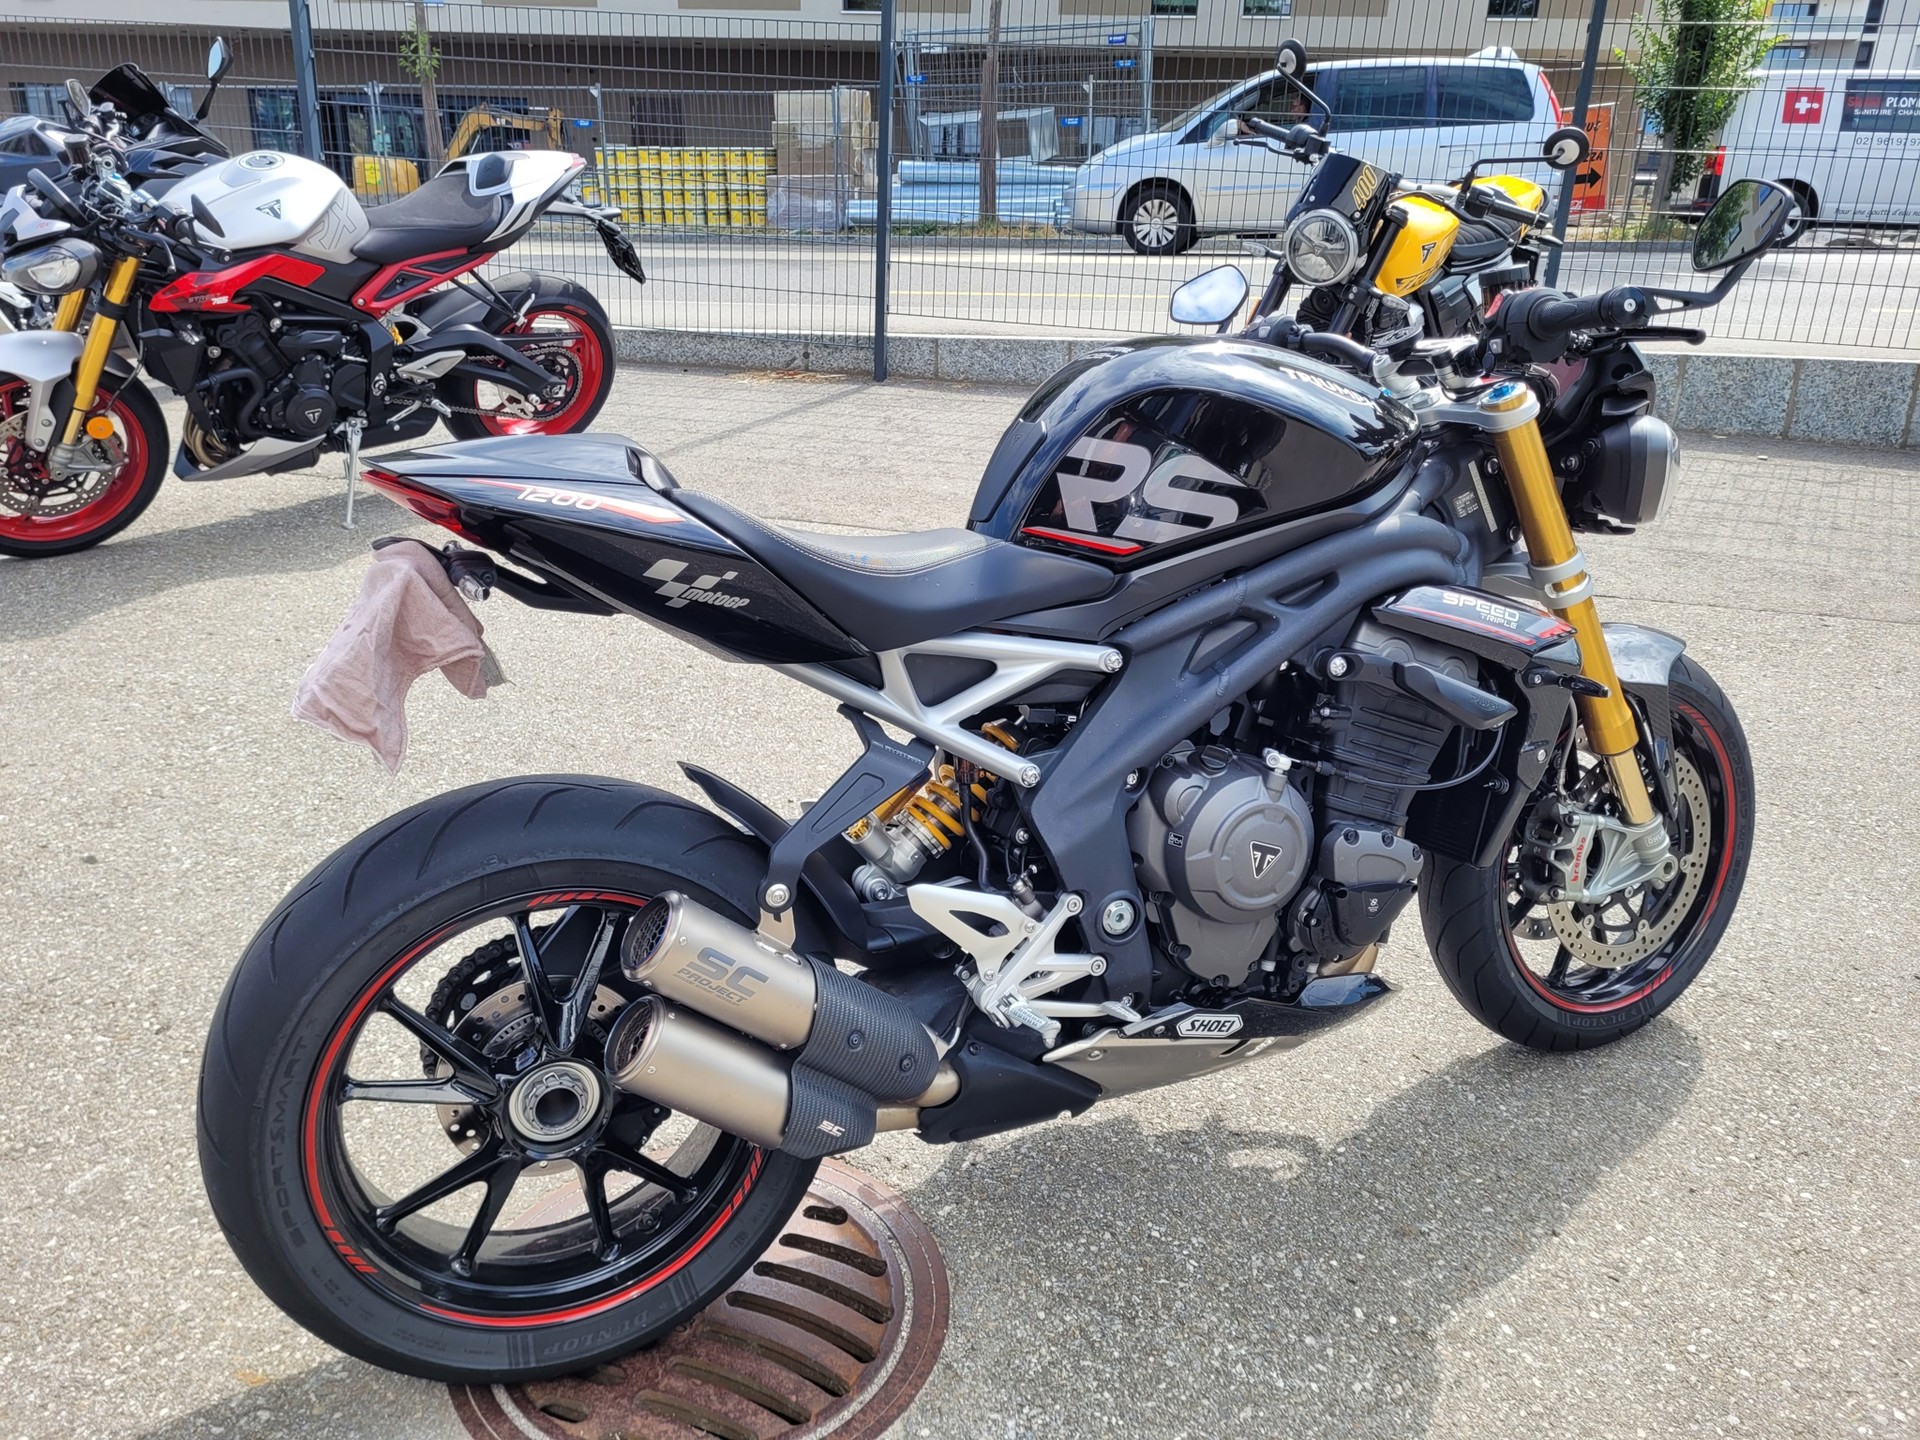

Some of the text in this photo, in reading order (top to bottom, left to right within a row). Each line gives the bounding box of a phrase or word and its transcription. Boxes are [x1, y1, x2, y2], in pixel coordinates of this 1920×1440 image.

[1886, 96, 1920, 108] PLOM
[1583, 152, 1603, 162] ZZA
[1352, 164, 1378, 210] 400
[517, 487, 604, 510] 1200
[1056, 436, 1248, 544] RS
[1443, 592, 1520, 623] SPEED
[1480, 612, 1517, 630] TRIPLE
[1570, 837, 1587, 883] brembo
[677, 967, 748, 1003] PROJECT
[686, 947, 769, 997] SC
[1186, 1020, 1236, 1033] SHOEI
[1572, 1012, 1627, 1027] DUNLOP
[543, 1309, 650, 1356] DUNLOP
